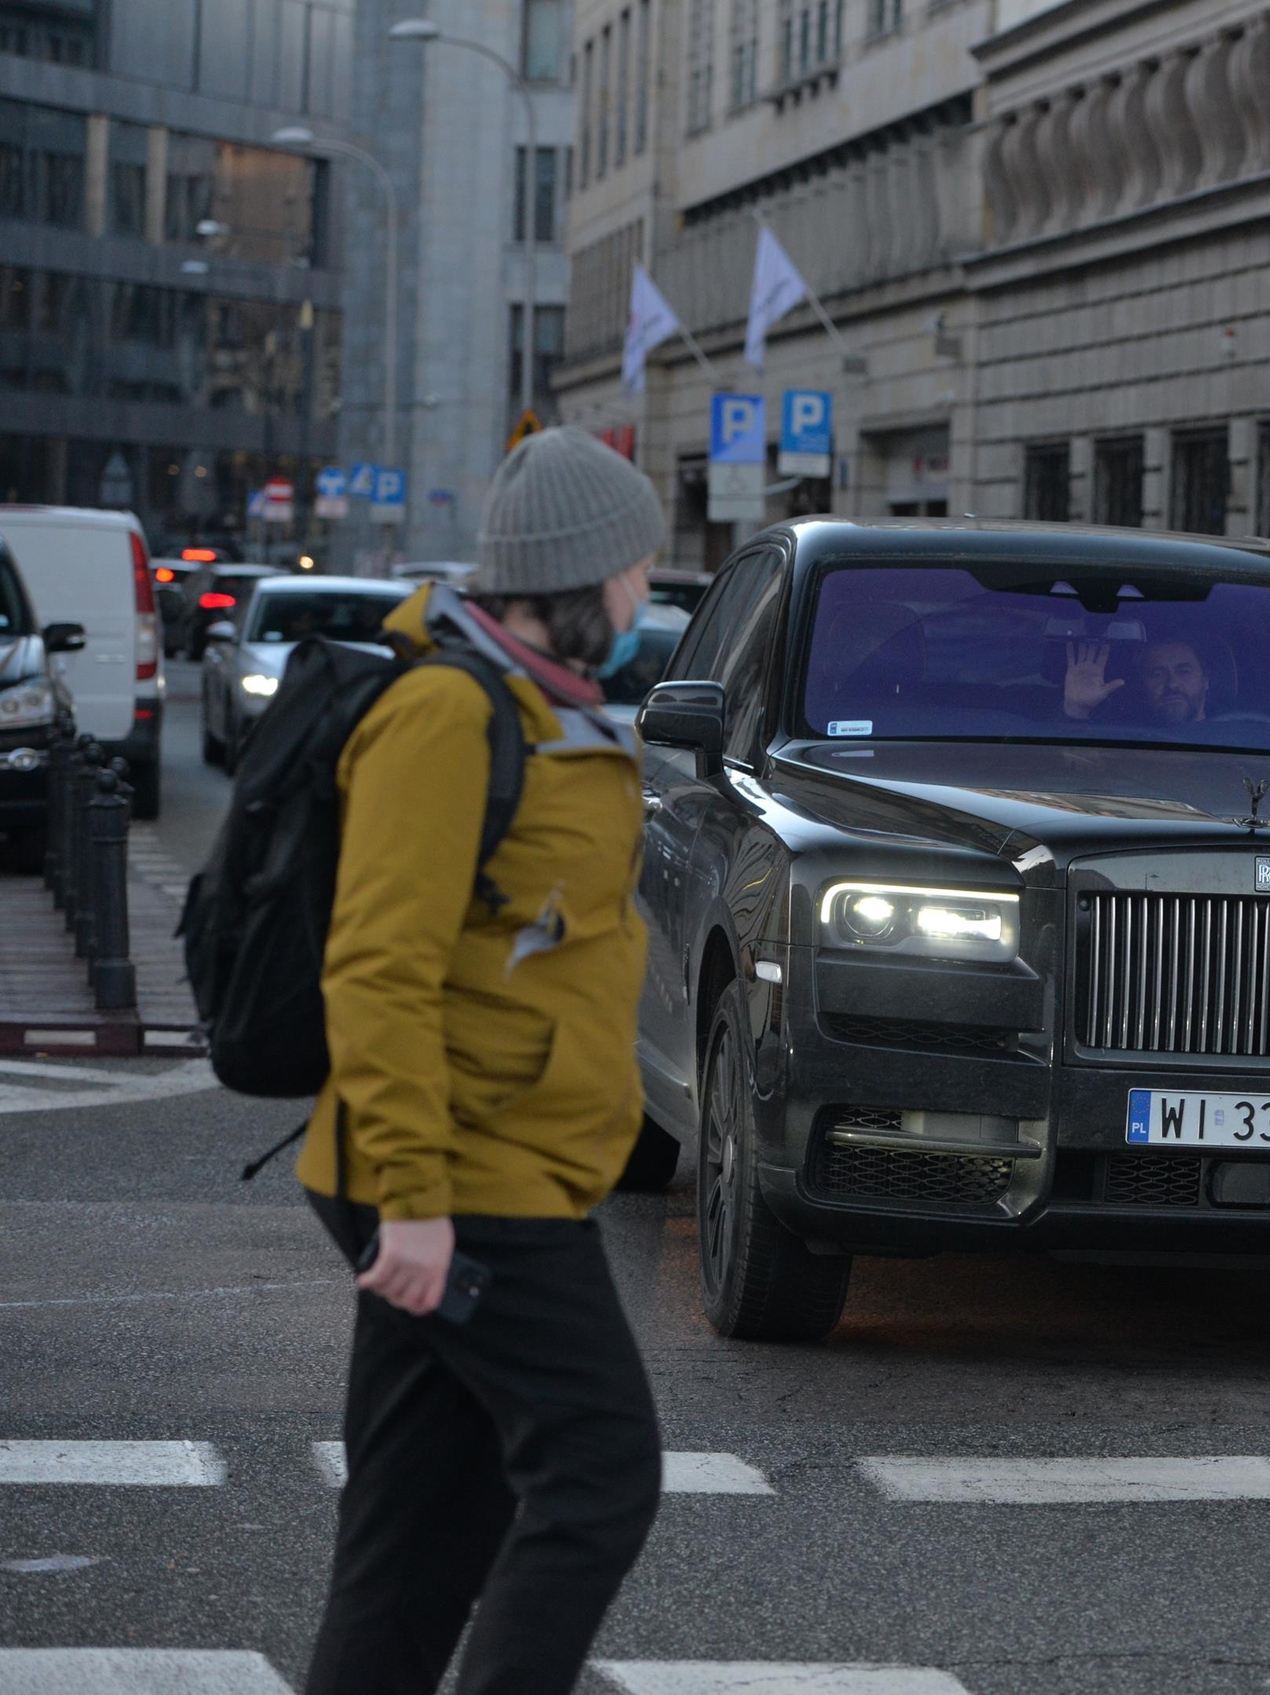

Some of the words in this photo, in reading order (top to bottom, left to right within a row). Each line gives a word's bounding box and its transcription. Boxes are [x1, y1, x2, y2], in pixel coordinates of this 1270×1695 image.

[723, 399, 755, 444] P
[792, 394, 824, 436] P
[1131, 1122, 1147, 1134] PL
[1161, 1098, 1206, 1139] WI
